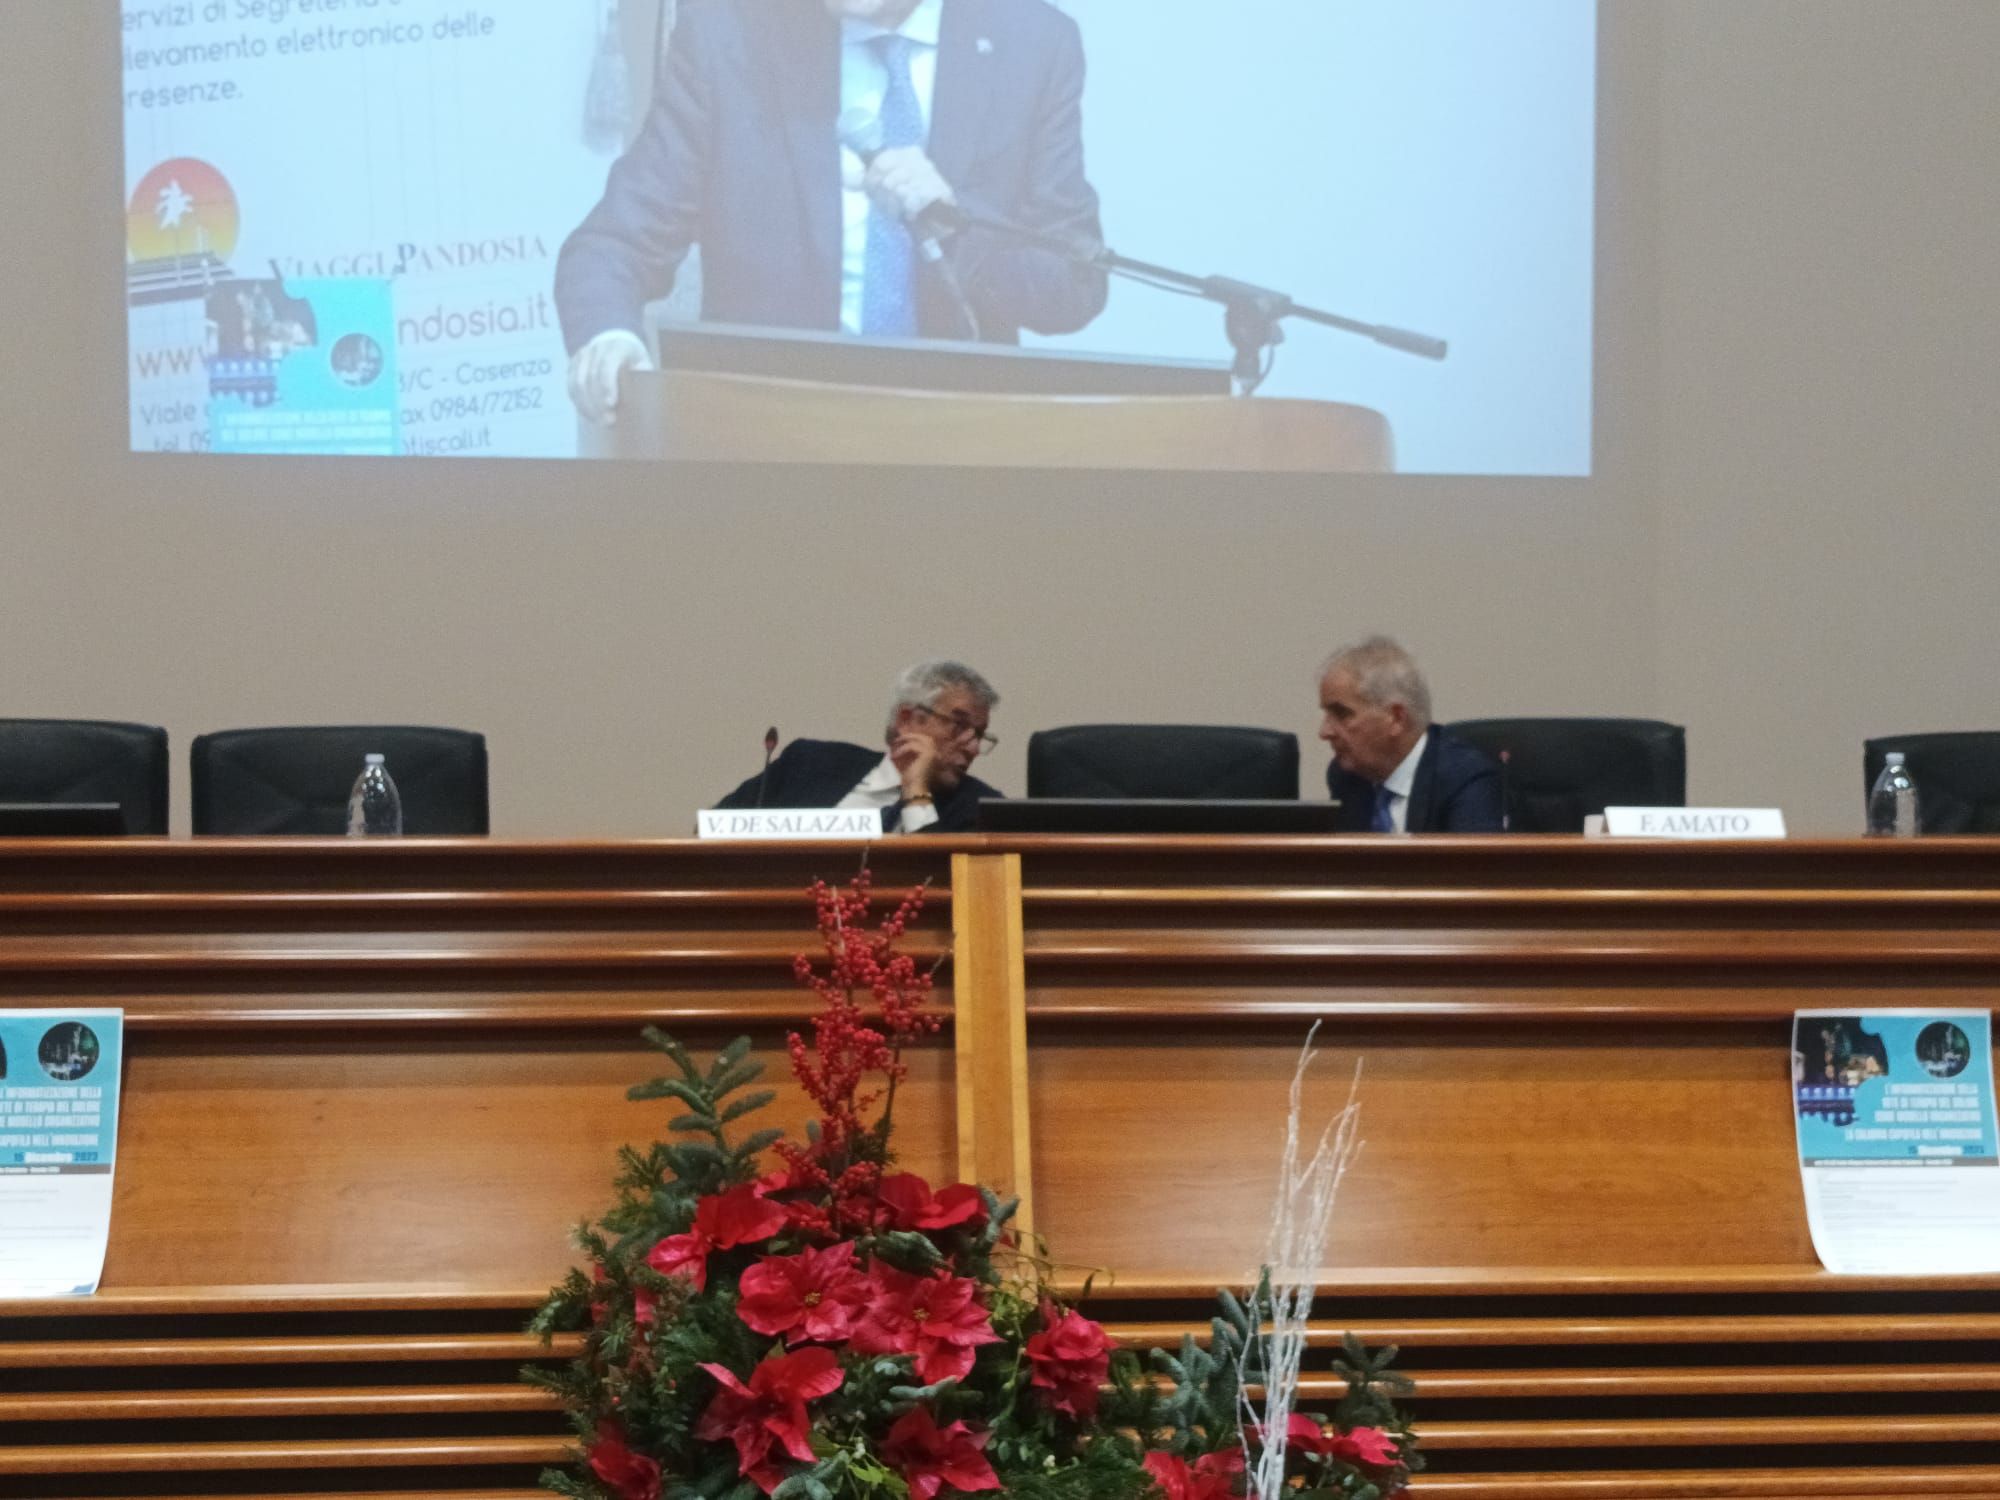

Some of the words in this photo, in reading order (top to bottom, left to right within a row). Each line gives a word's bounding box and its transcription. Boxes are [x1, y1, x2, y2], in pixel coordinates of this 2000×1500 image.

[276, 20, 424, 54] elettronico
[432, 12, 496, 40] delle
[392, 235, 547, 273] PANDOSIA
[398, 292, 549, 344] ndosia.it
[707, 816, 723, 833] V.
[726, 815, 762, 833] DE
[766, 814, 872, 833] SALAZAR
[1640, 815, 1655, 832] F.
[1661, 814, 1749, 833] AMATO
